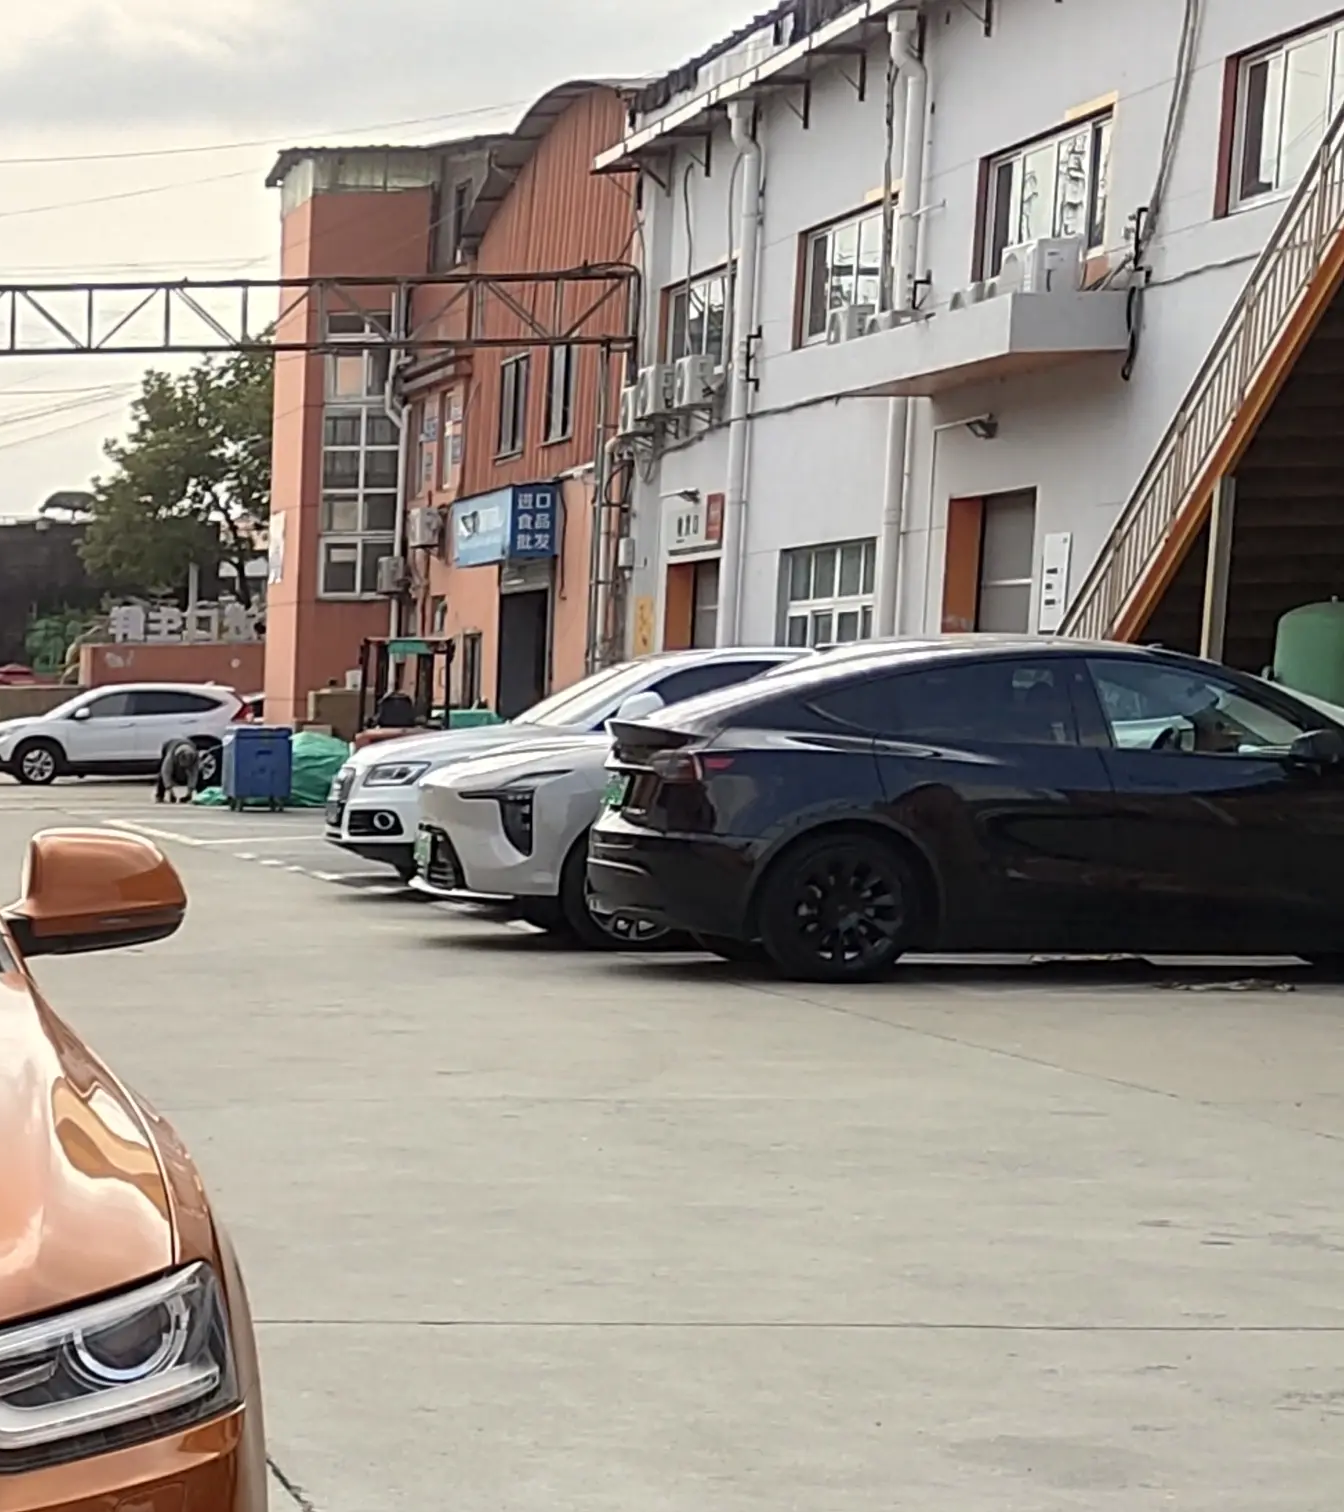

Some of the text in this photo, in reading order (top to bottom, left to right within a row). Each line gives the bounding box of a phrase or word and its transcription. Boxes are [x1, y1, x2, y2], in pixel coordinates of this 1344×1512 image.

[517, 493, 551, 510] 进口
[517, 513, 550, 530] 食品
[516, 533, 550, 550] 批发
